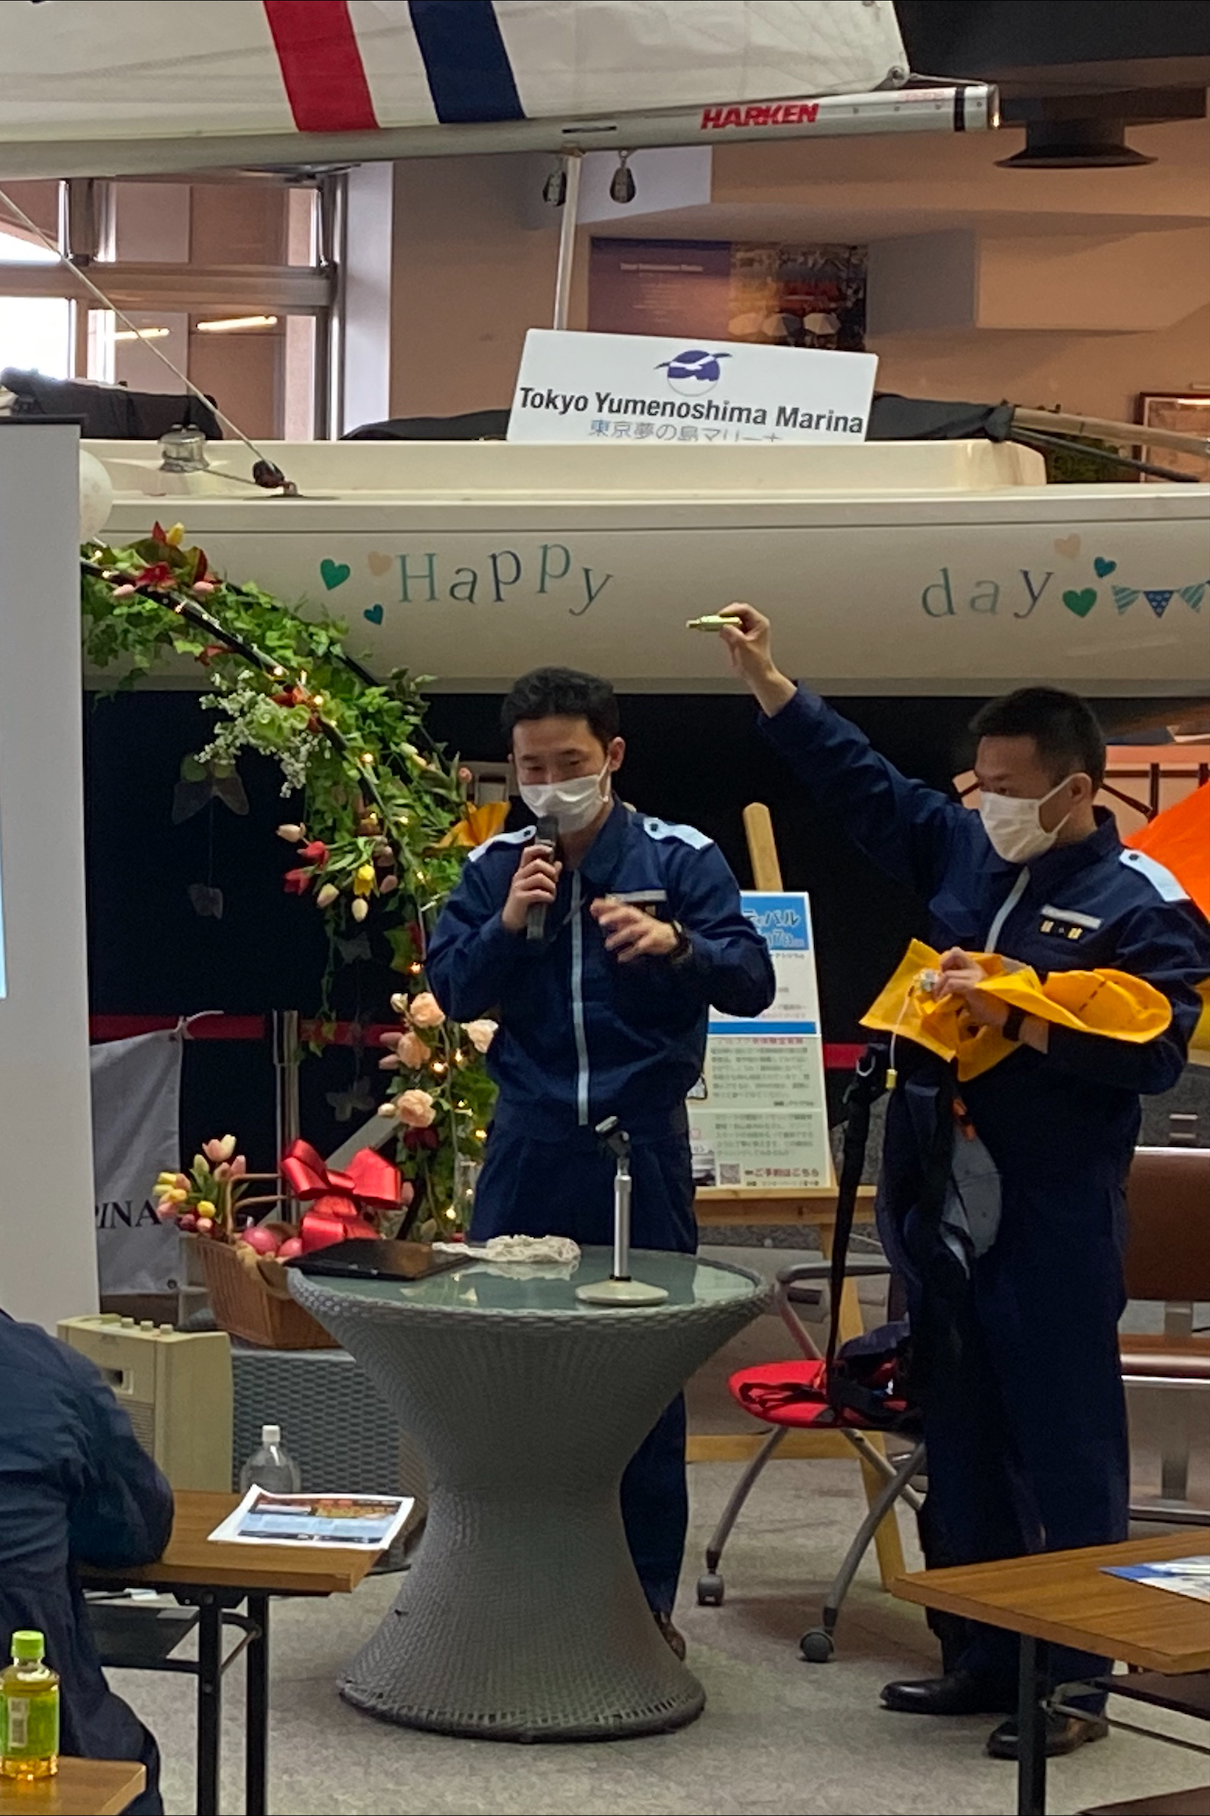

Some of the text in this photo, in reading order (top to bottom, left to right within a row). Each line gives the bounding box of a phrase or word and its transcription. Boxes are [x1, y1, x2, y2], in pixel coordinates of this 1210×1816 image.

[700, 102, 820, 130] HARKEN
[519, 386, 864, 434] Tokyo Yumenoshima Marina
[396, 543, 1055, 619] Happy day
[95, 1198, 162, 1230] INA
